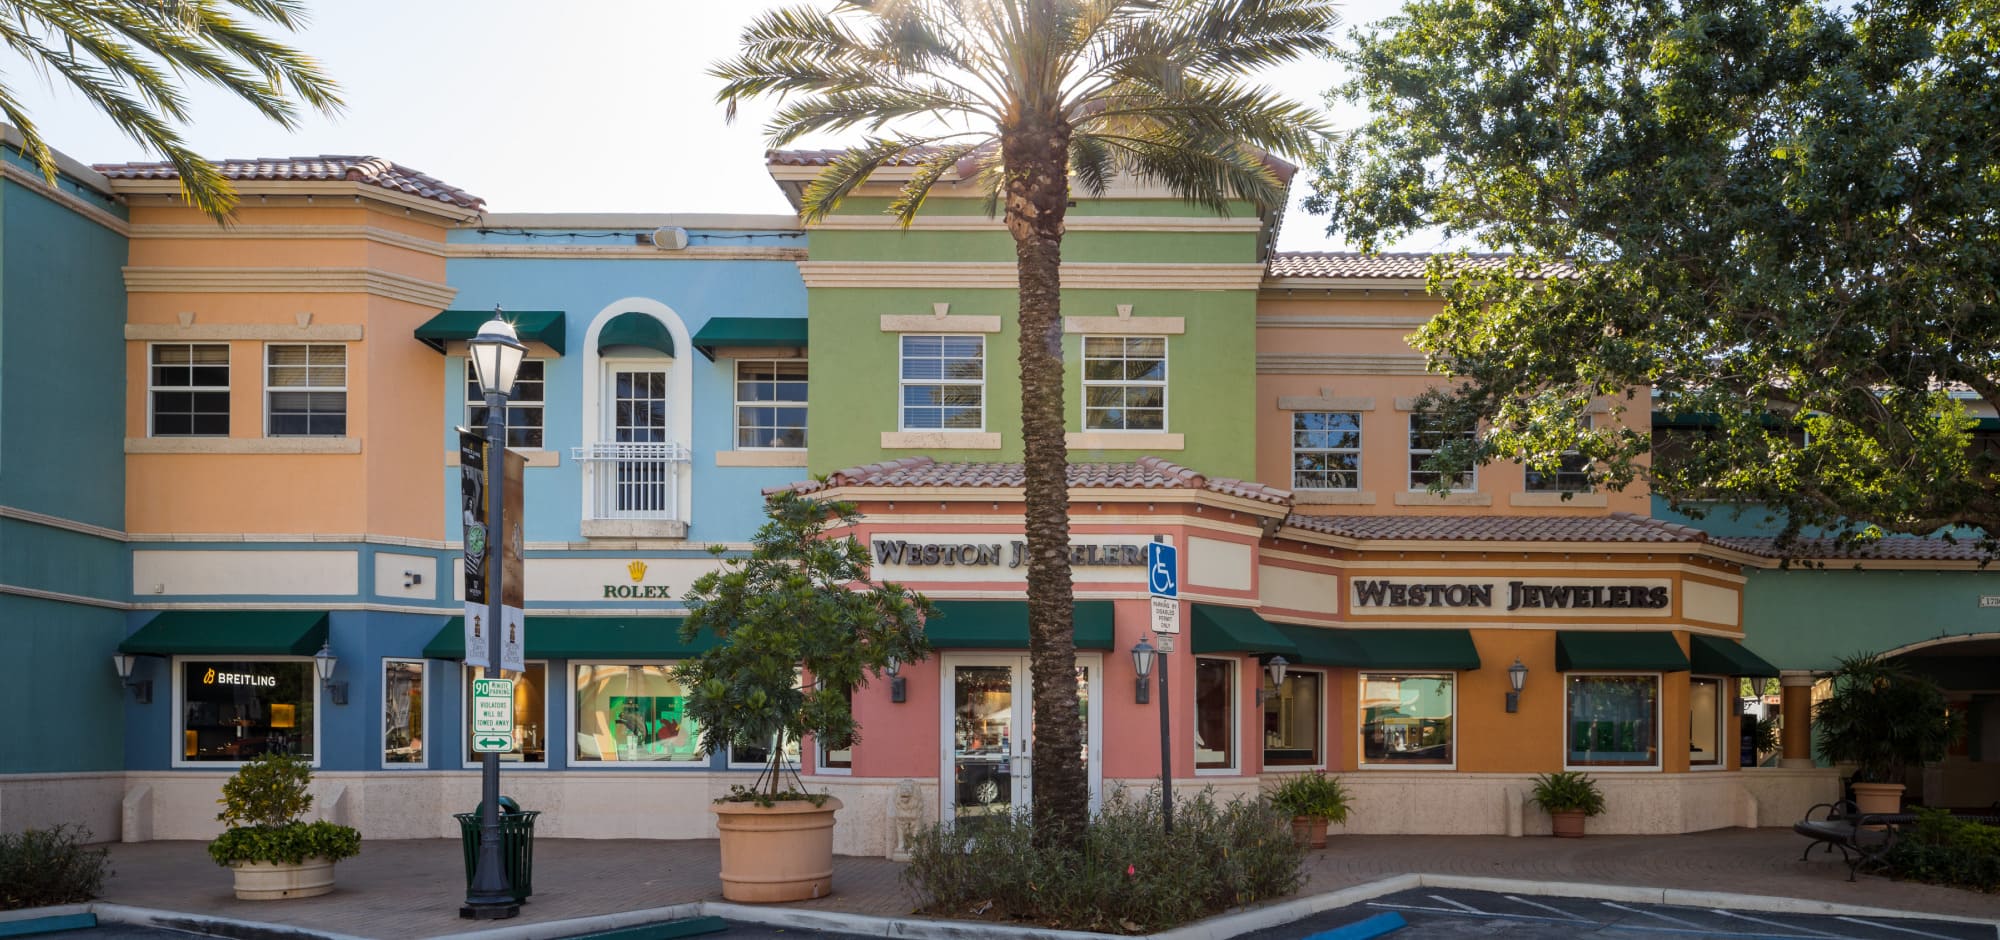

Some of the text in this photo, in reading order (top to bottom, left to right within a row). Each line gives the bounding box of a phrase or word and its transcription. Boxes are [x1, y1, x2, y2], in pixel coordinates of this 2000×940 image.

[873, 540, 1001, 566] WESTON
[603, 585, 671, 598] ROLEX
[1354, 580, 1668, 611] WESTON JEWELERS
[218, 672, 277, 687] BREITLING
[475, 682, 489, 695] 90
